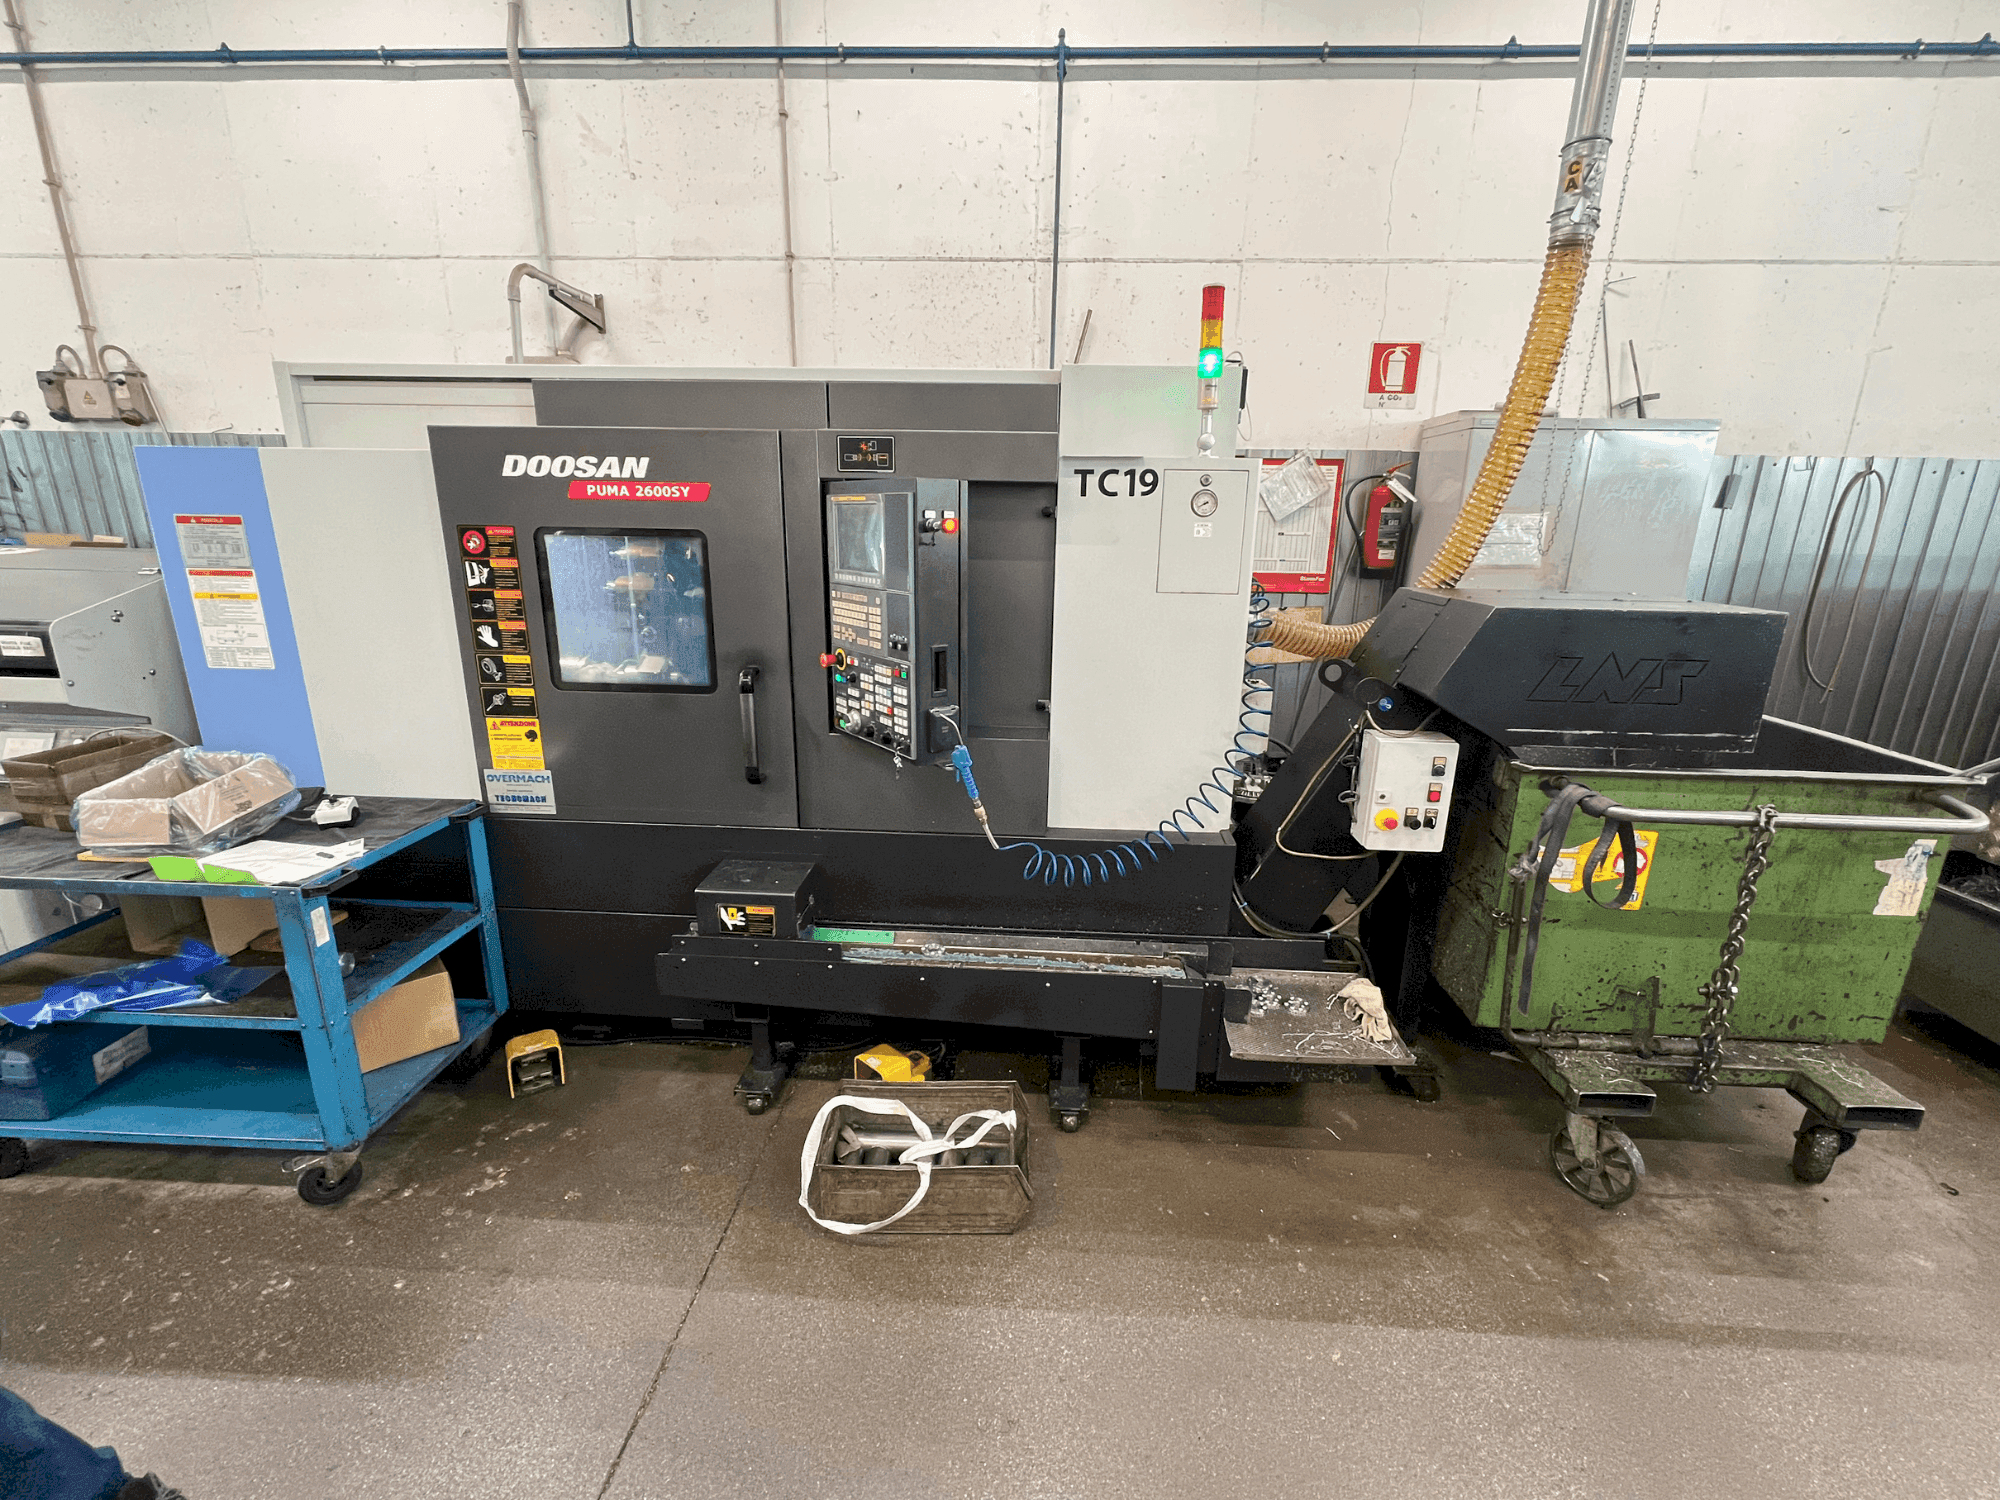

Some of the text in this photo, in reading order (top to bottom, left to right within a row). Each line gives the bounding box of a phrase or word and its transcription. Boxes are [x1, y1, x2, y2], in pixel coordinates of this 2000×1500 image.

[502, 454, 649, 478] DOOSAN
[586, 484, 690, 498] PUMA 2600SY
[1074, 468, 1159, 497] TC19
[486, 774, 551, 784] OVERMACH
